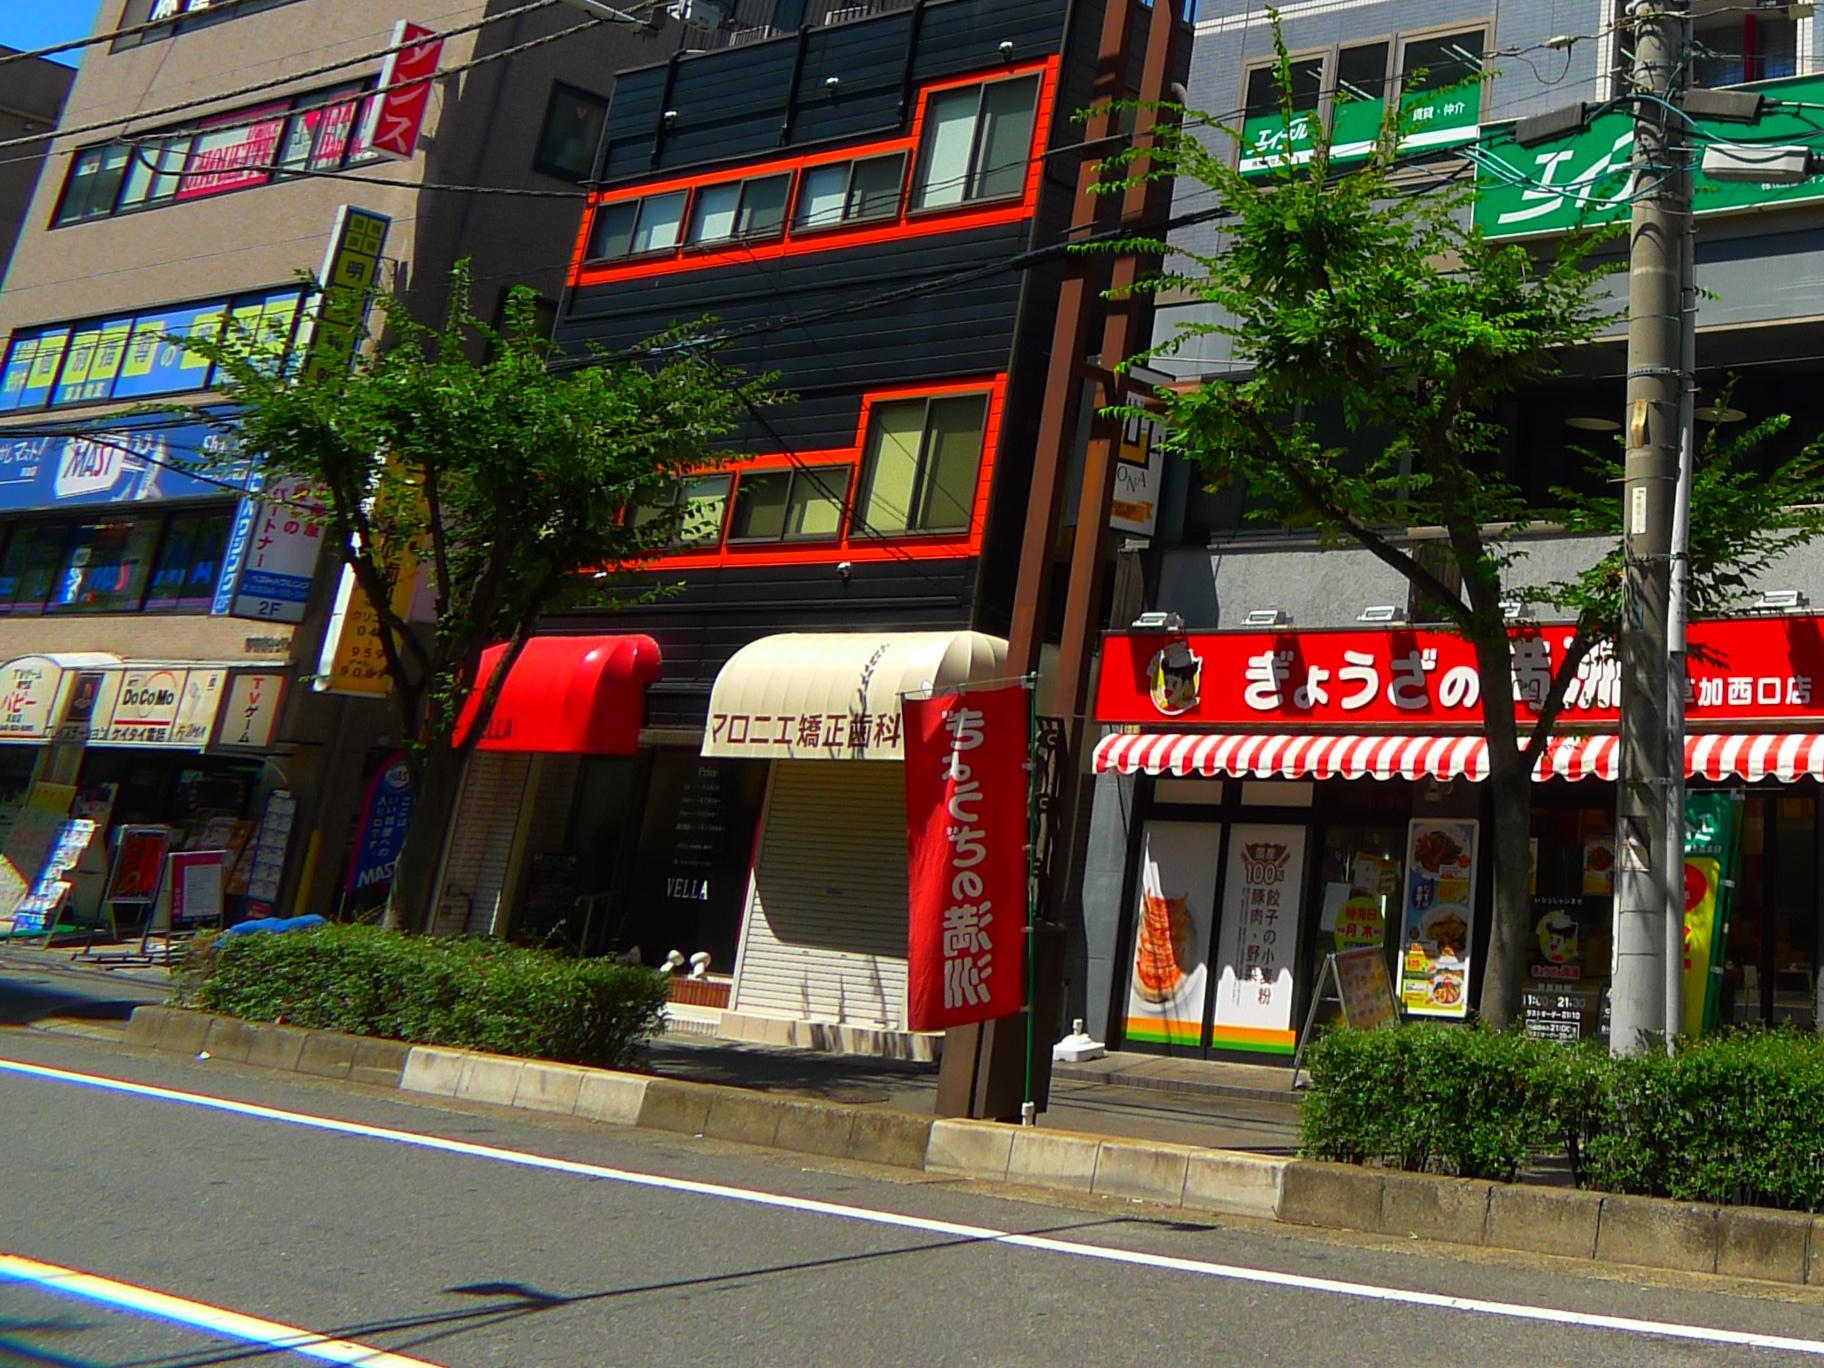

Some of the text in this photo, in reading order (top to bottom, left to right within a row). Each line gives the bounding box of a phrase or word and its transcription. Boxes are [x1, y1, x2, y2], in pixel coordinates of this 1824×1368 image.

[1116, 465, 1147, 493] ONA
[258, 601, 283, 616] 2F
[122, 688, 175, 707] DoCoMo
[711, 713, 902, 748] マロニエ矯正歯科
[667, 877, 708, 900] VELLA
